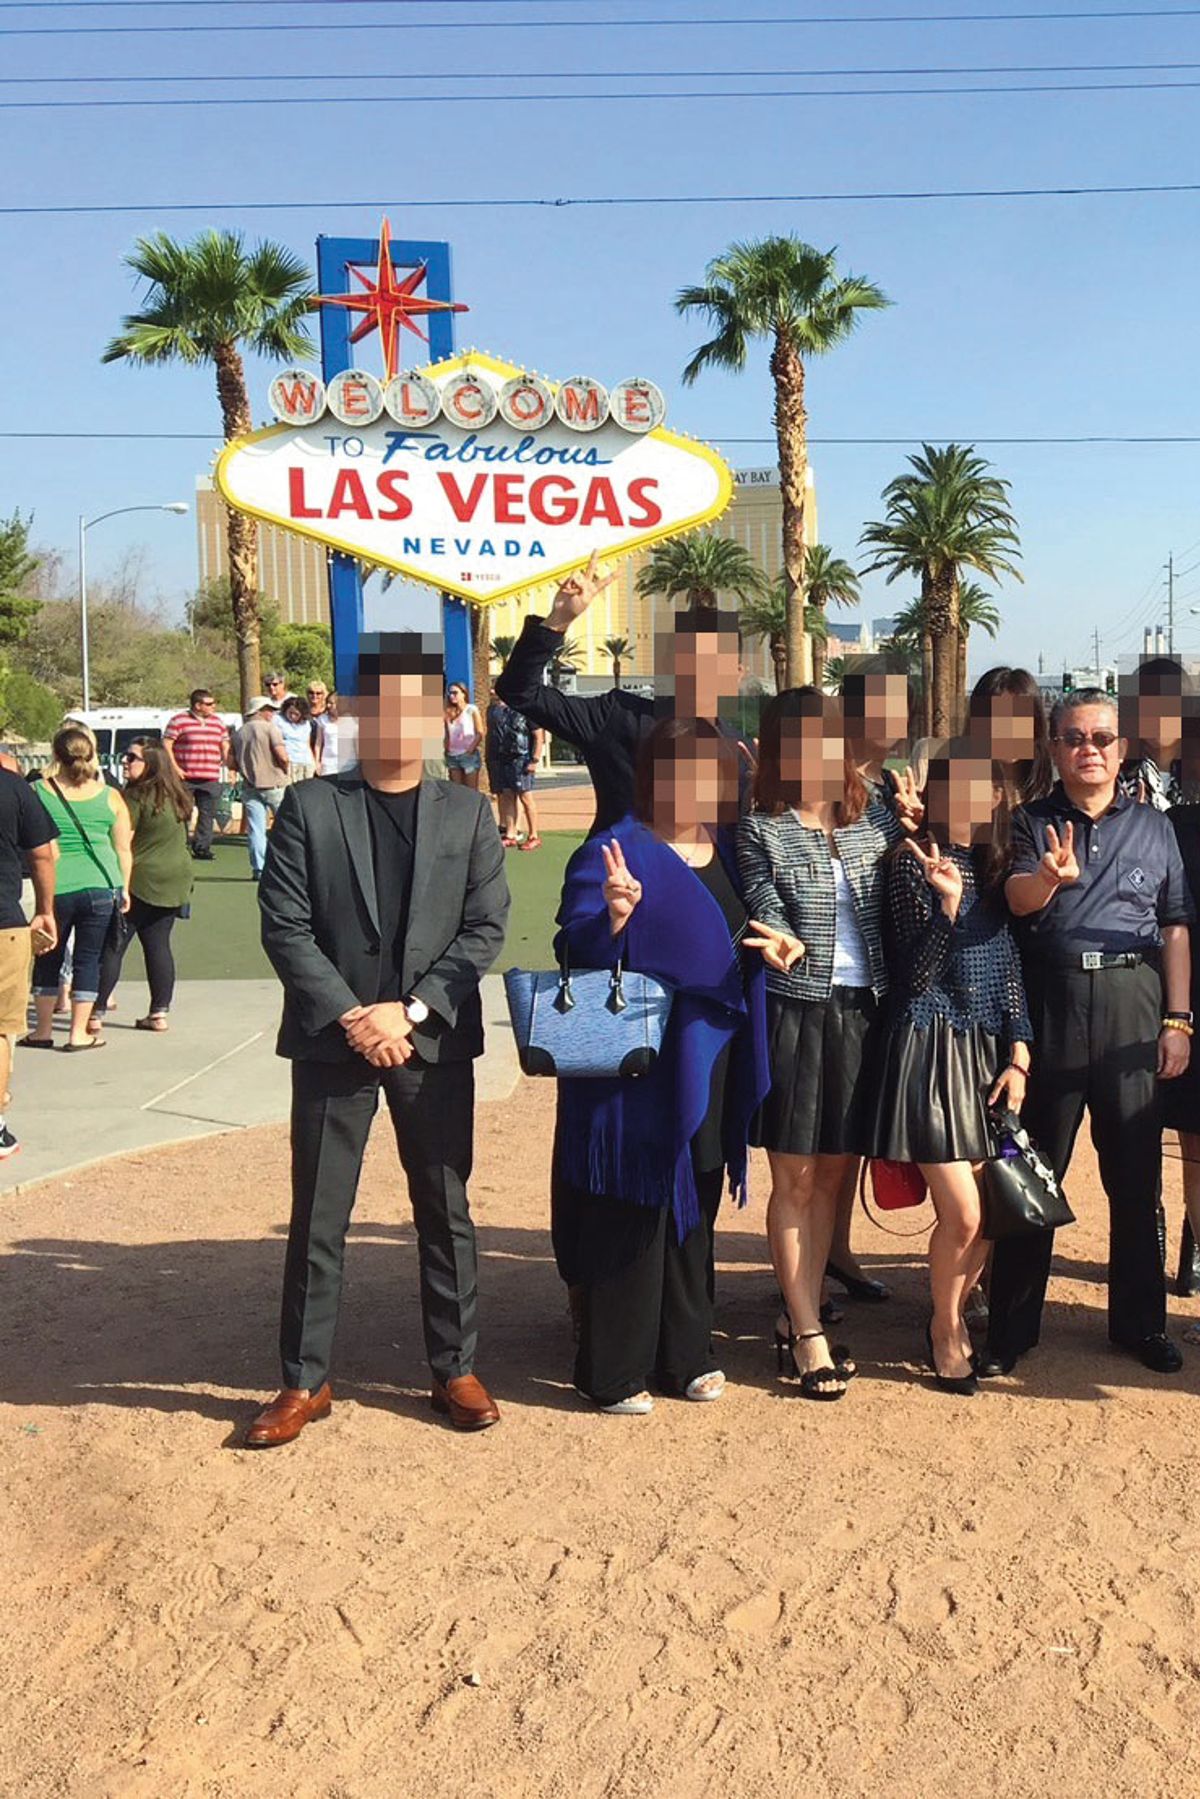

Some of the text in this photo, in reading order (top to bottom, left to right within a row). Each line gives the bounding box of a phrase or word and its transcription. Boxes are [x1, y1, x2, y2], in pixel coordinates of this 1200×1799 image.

[276, 379, 652, 424] WELCOME
[323, 430, 613, 466] TO Fabulous
[733, 470, 772, 484] AY BAY
[287, 466, 664, 528] LAS VEGAS
[402, 536, 547, 559] NEVADA
